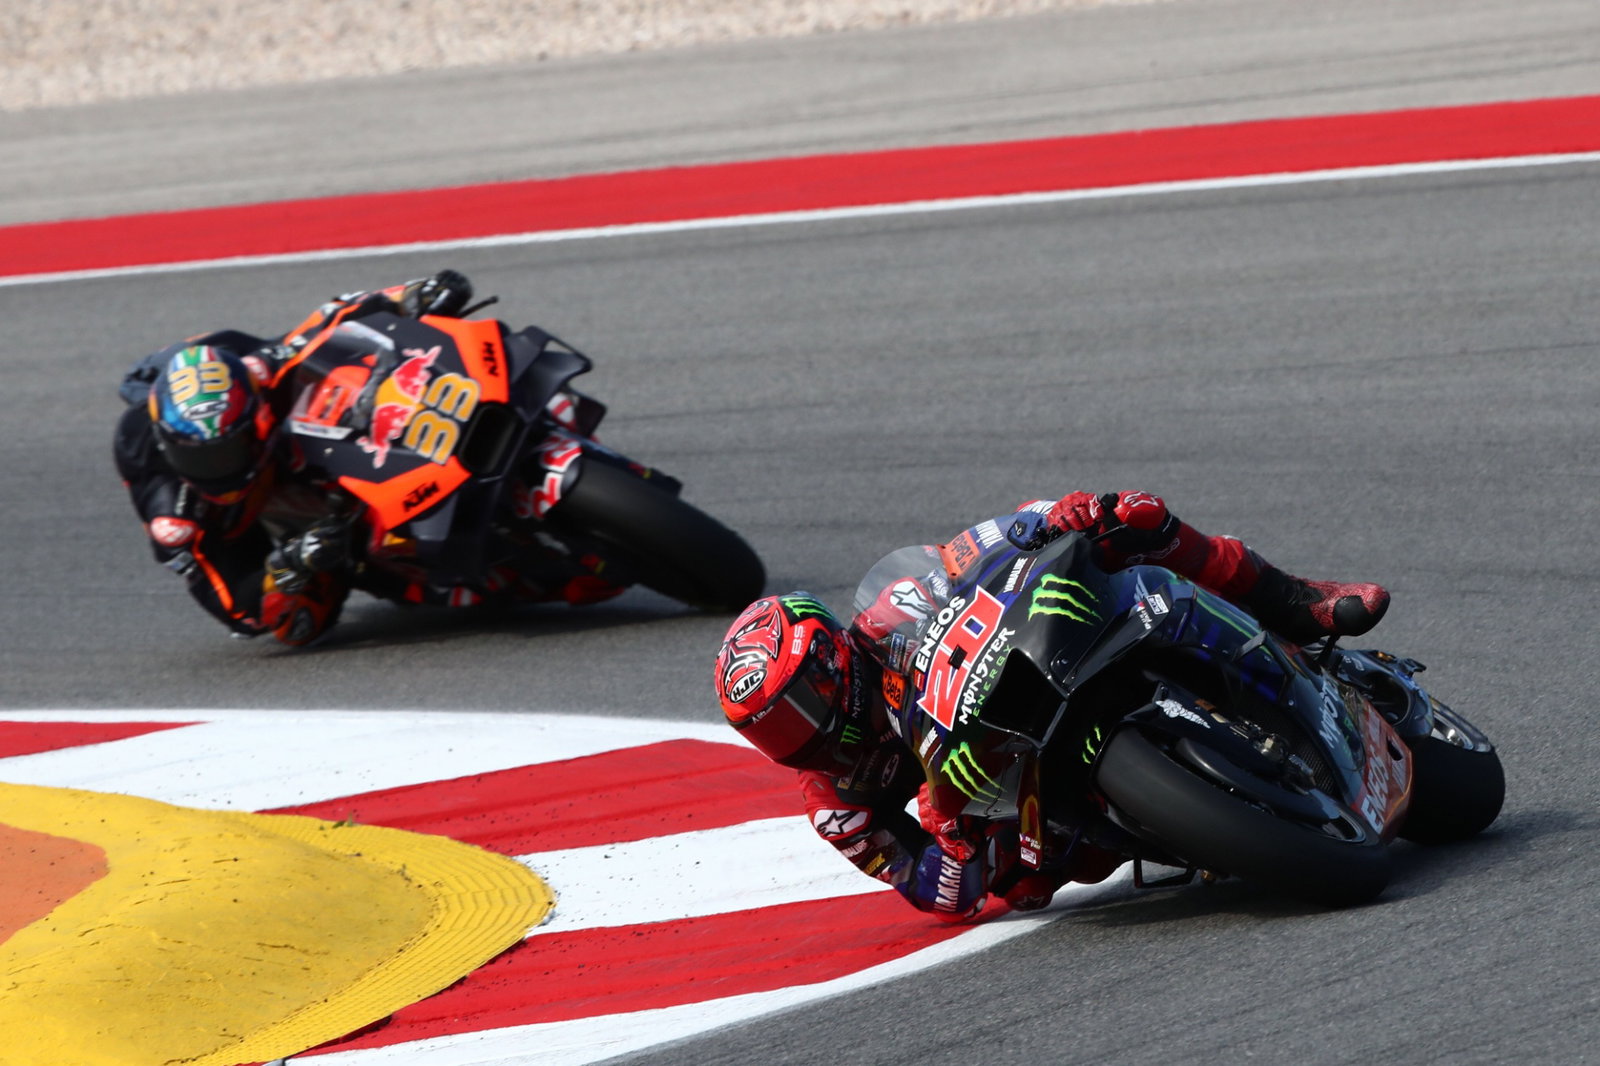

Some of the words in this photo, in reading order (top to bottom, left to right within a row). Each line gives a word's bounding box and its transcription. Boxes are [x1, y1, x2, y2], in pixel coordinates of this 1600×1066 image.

[404, 373, 481, 465] 33
[403, 483, 441, 511] KTM
[791, 624, 804, 655] BS
[915, 596, 966, 673] ENEOS
[732, 671, 762, 699] HJC
[958, 627, 1016, 725] MONSTER
[973, 643, 1014, 718] ENERGY
